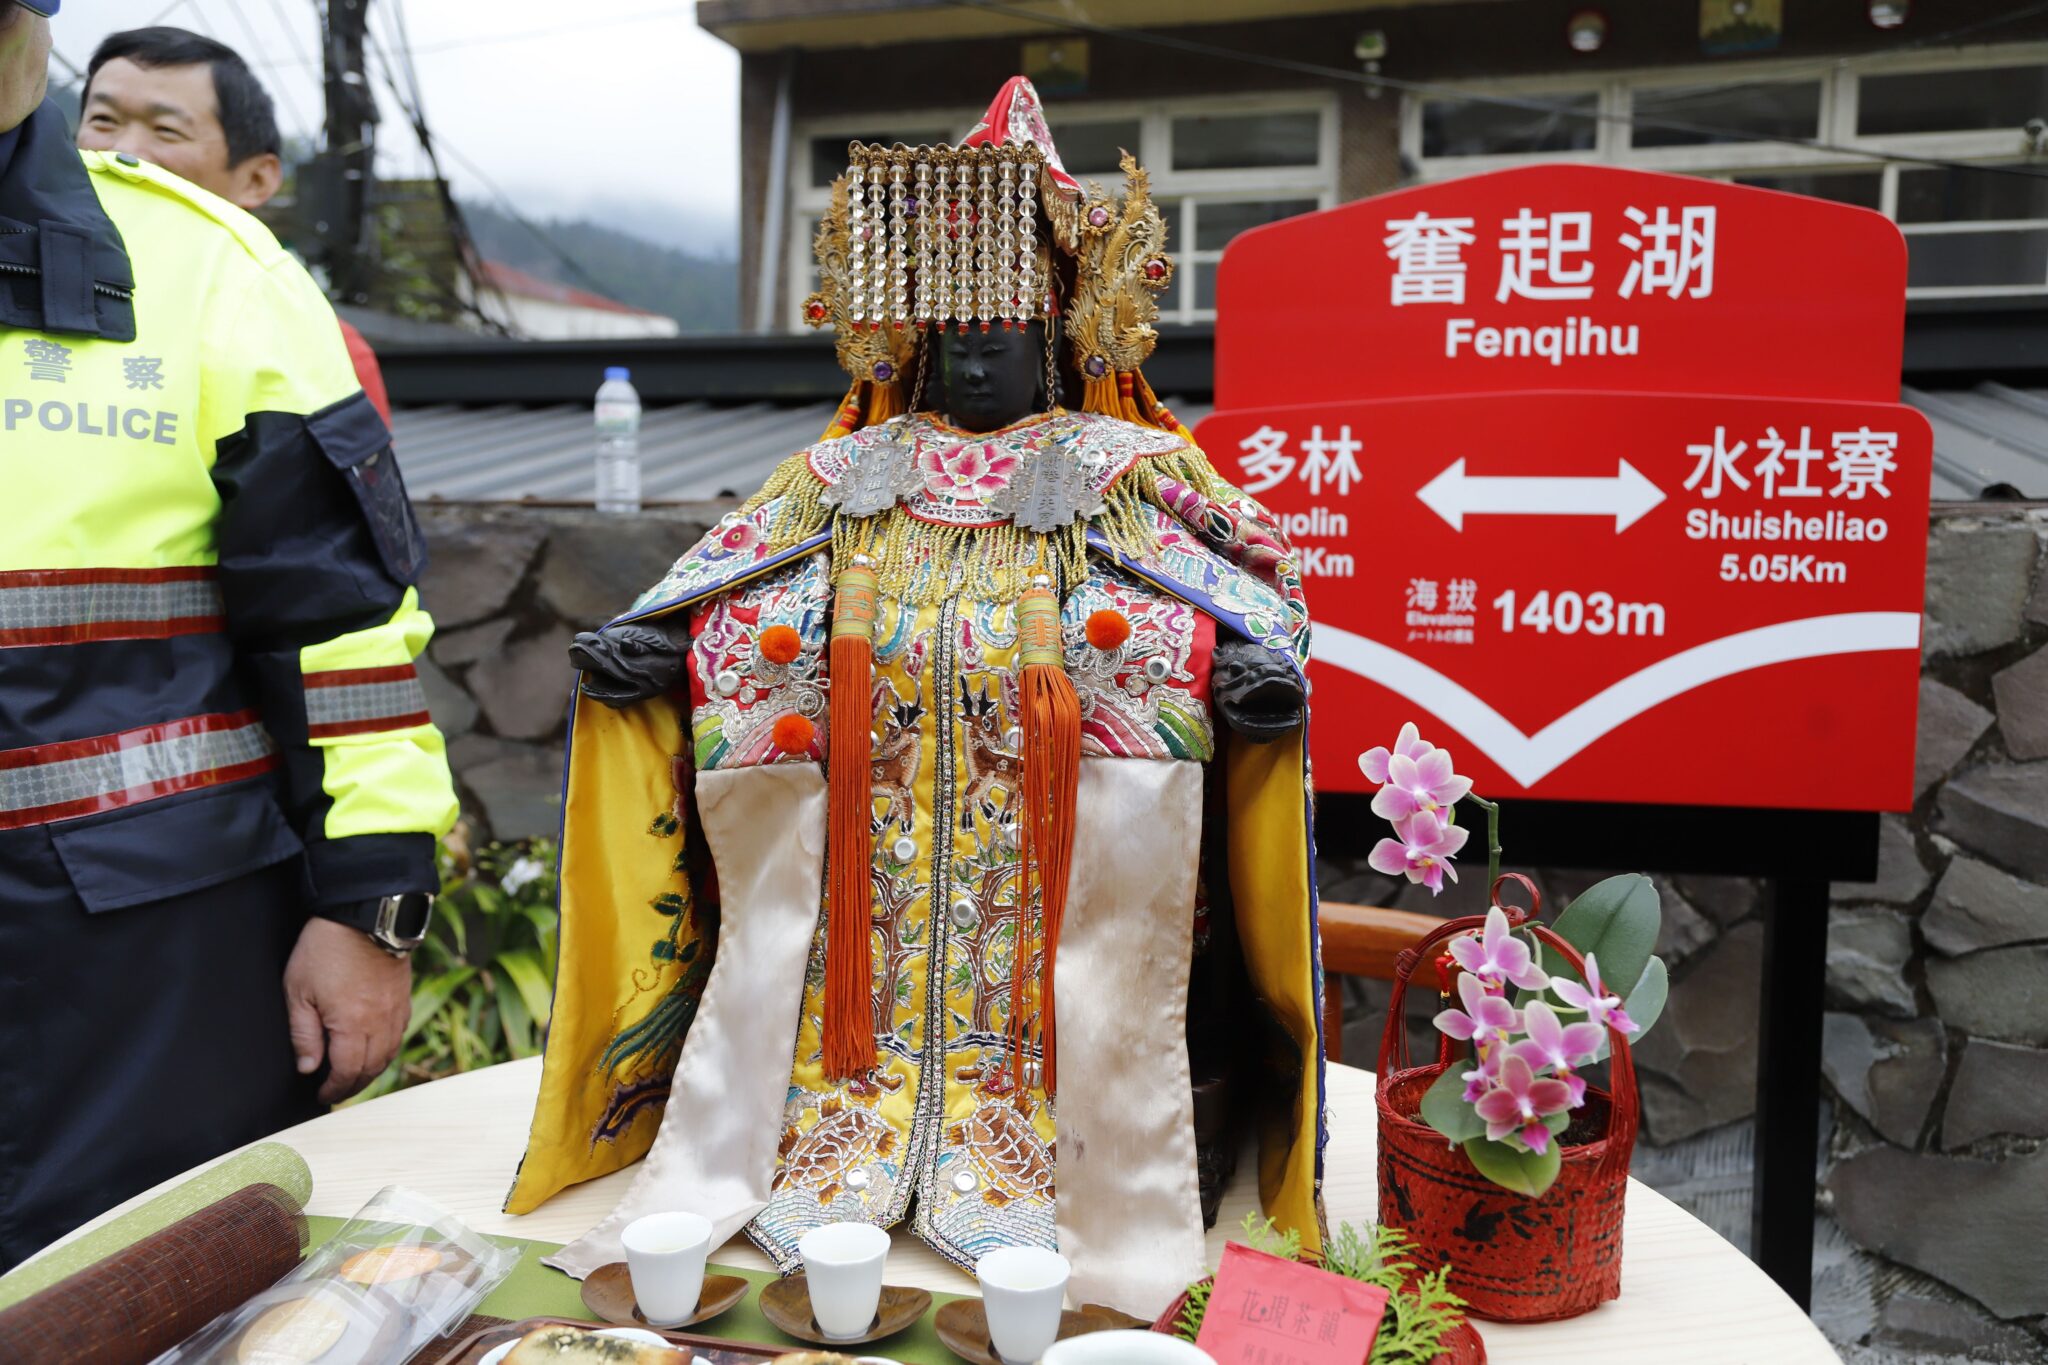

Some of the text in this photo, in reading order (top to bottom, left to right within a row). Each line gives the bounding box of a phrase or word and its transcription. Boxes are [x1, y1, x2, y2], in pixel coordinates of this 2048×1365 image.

[1384, 205, 1718, 307] 奮起湖
[23, 338, 166, 391] 警察
[1445, 317, 1640, 366] Fenqihu
[4, 398, 179, 446] POLICE
[1237, 424, 1364, 496] 多林
[1682, 425, 1899, 501] 水社寮
[1272, 506, 1348, 537] uolin
[1685, 508, 1889, 542] Shuisheliao
[1719, 553, 1848, 583] 5.05Km
[1405, 577, 1478, 612] 海拔
[1406, 610, 1475, 627] Elevation
[1493, 588, 1666, 636] 1403m
